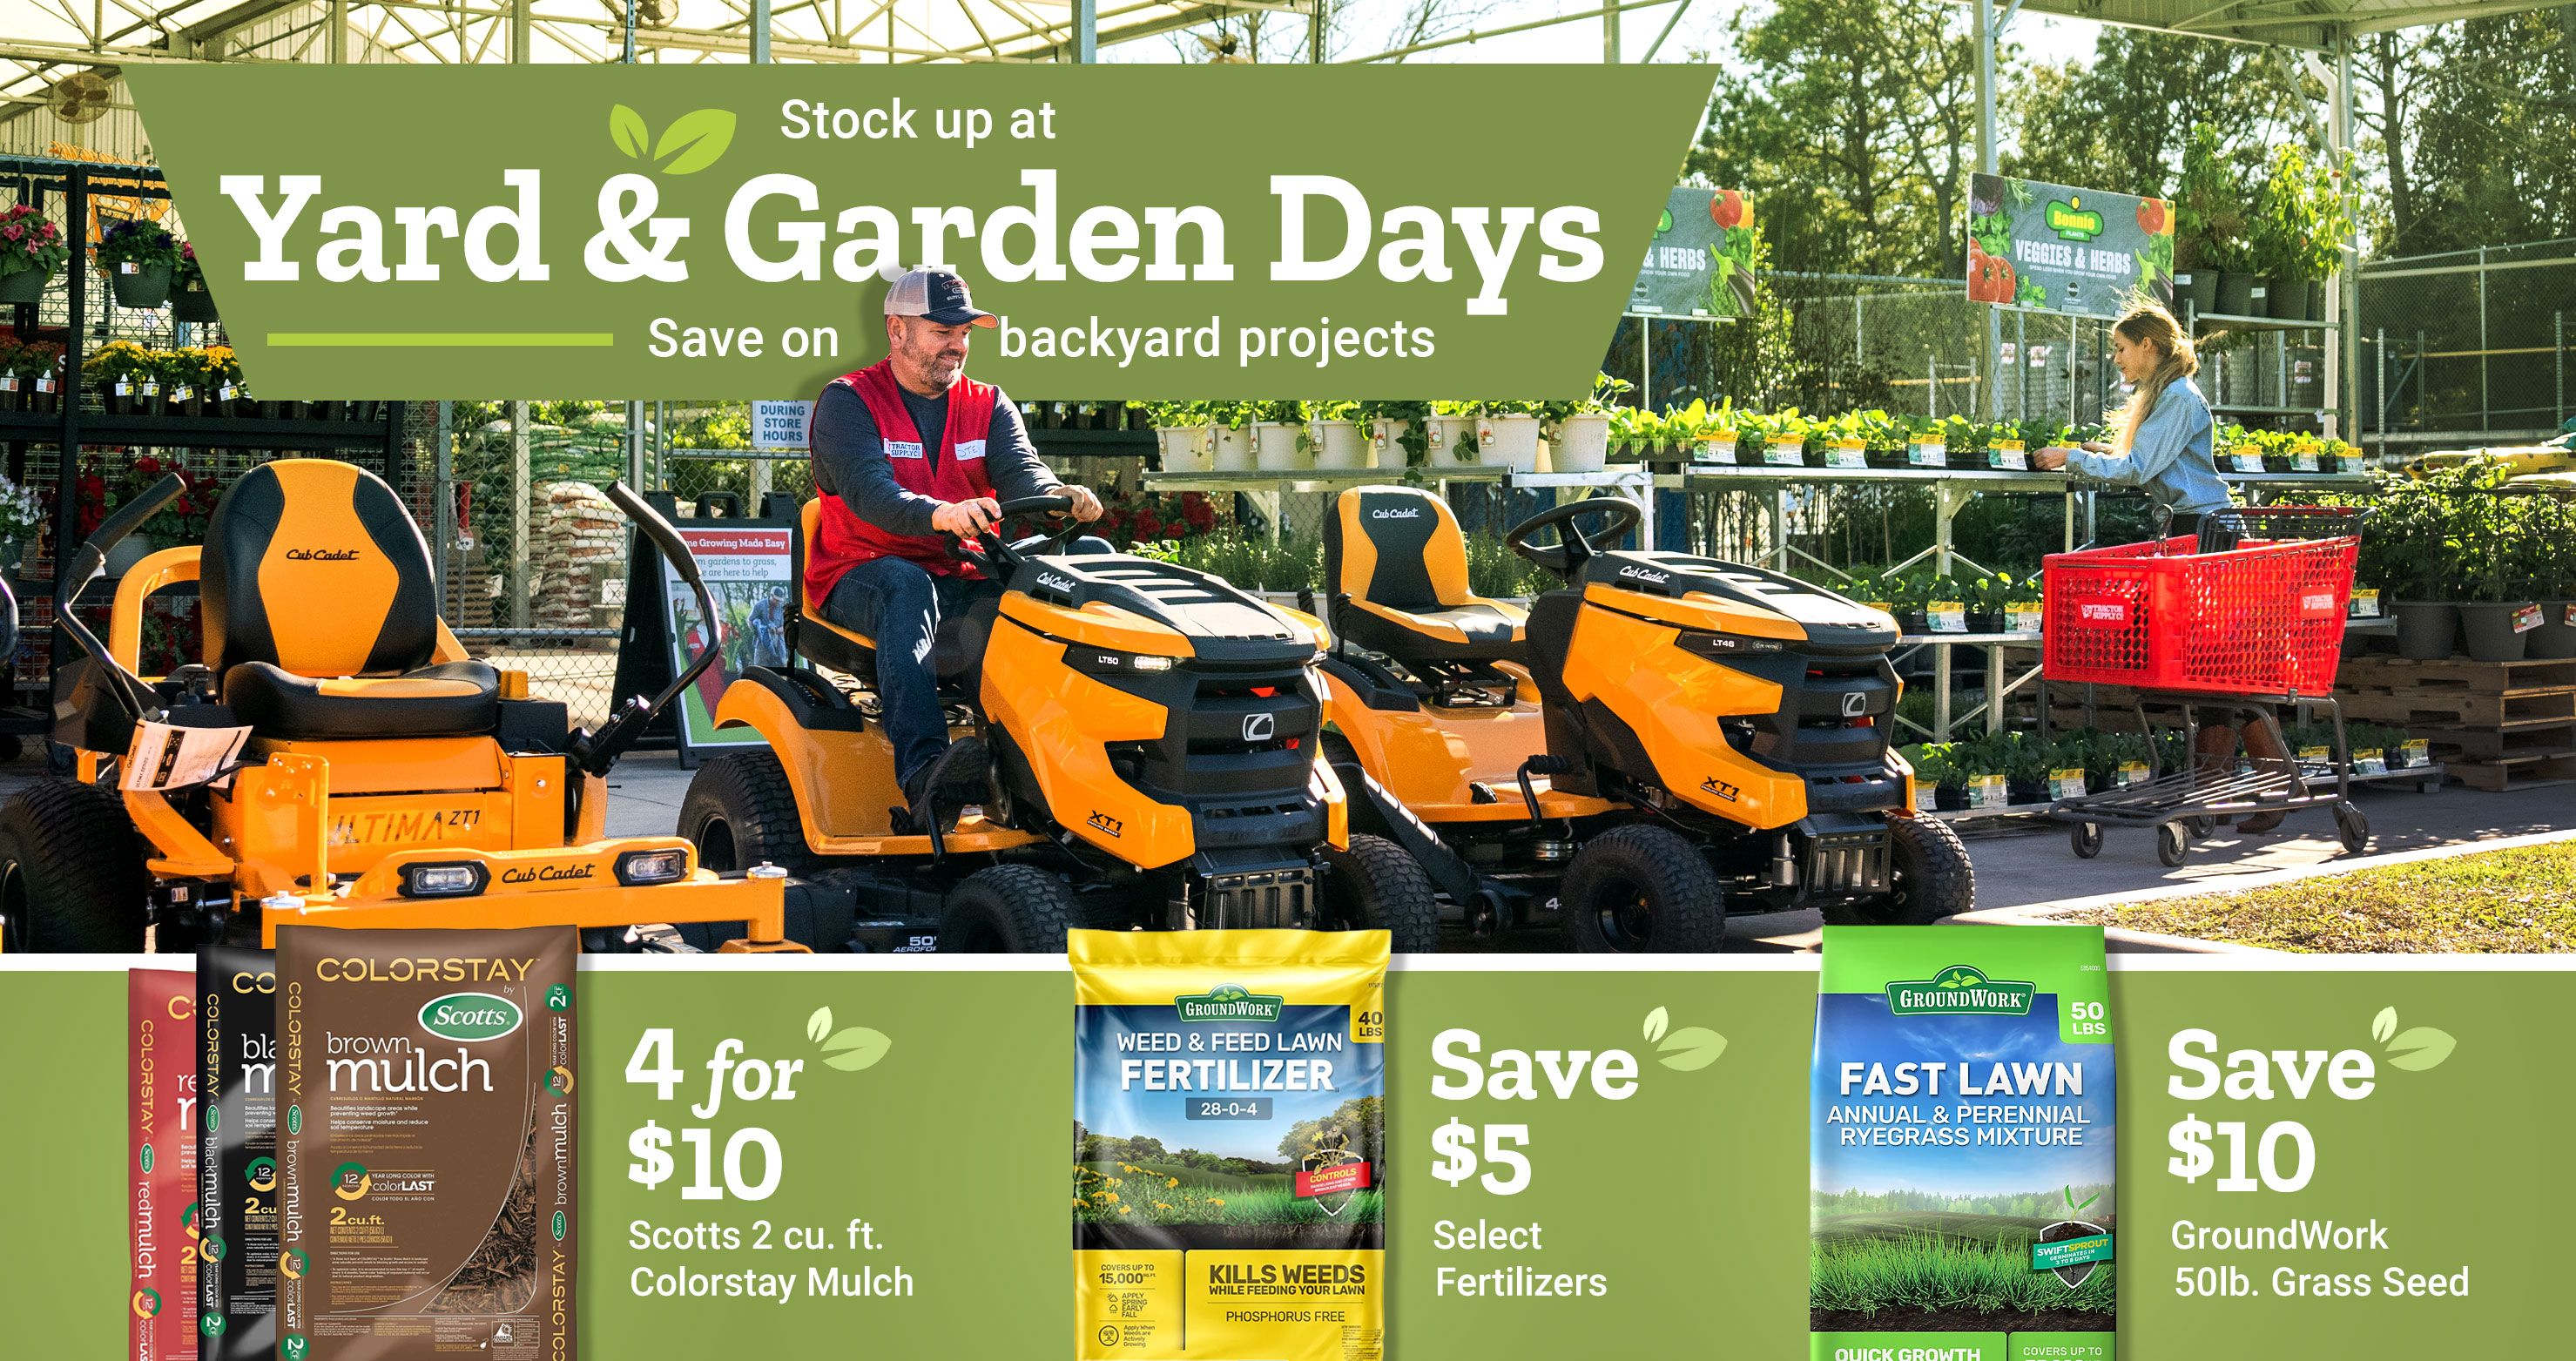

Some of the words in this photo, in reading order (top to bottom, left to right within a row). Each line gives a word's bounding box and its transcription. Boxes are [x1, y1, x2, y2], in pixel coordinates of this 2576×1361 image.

[2053, 210, 2095, 230] Bonnie
[1660, 246, 1706, 271] HERBS
[2015, 239, 2072, 267] VEGGIES
[2074, 247, 2086, 269] &
[2090, 249, 2131, 274] HERBS
[760, 406, 805, 417] DURING
[764, 418, 801, 428] STORE
[763, 430, 803, 441] HOURS
[891, 442, 921, 451] TRACTOR
[1372, 509, 1389, 519] Cub
[1390, 508, 1419, 519] Cadet
[699, 538, 738, 549] Growing
[739, 539, 763, 548] Made
[765, 539, 786, 549] Easy
[287, 549, 312, 561] Cub
[314, 549, 360, 561] Cadet
[708, 556, 740, 567] gardens
[753, 559, 777, 568] grass,
[724, 568, 740, 576] here
[753, 567, 769, 578] help
[1619, 565, 1638, 577] Cub
[1637, 569, 1670, 584] Cadet
[1036, 571, 1051, 585] Cub
[1049, 576, 1076, 593] Cadet
[1713, 639, 1735, 648] LT46
[1098, 656, 1119, 665] LT50
[1703, 776, 1739, 797] XT1
[448, 810, 481, 825] ZT1
[1089, 810, 1123, 832] XT1
[502, 868, 535, 884] Cub
[538, 863, 596, 881] Cadet
[316, 957, 535, 982] COLORSTAY
[503, 985, 516, 995] by
[550, 995, 566, 1007] 2
[433, 1005, 507, 1026] Scotts
[1358, 1011, 1383, 1025] 40
[2071, 1001, 2104, 1021] 50
[1359, 1027, 1382, 1036] LBS
[2073, 1022, 2106, 1035] LBS
[206, 993, 219, 1097] COLORSTAY
[288, 981, 302, 1096] COLORSTAY
[327, 1031, 412, 1054] brown
[1117, 1033, 1181, 1052] WEED
[1189, 1033, 1205, 1052] &
[1211, 1033, 1271, 1052] FEED
[1278, 1033, 1342, 1052] LAWN
[141, 1020, 153, 1135] COLORSTAY
[327, 1047, 494, 1093] mulch
[1121, 1059, 1334, 1091] FERTILIZER
[1841, 1062, 1946, 1095] FAST
[1959, 1062, 2083, 1095] LAWN
[1201, 1102, 1258, 1116] 28-0-4
[1827, 1106, 1926, 1124] ANNUAL
[1932, 1106, 1950, 1124] &
[1958, 1106, 2091, 1124] PERENNIAL
[1841, 1128, 1970, 1146] RYEGRASS
[1977, 1128, 2083, 1146] MIXTURE
[551, 1103, 567, 1205] brownmulch
[258, 1167, 271, 1176] 12
[344, 1174, 359, 1184] 12
[1310, 1168, 1357, 1183] CONTROLS
[205, 1137, 221, 1230] blackmulch
[373, 1180, 435, 1192] colorLAST
[287, 1141, 303, 1243] brownmulch
[245, 1197, 260, 1214] 2
[330, 1206, 347, 1225] 2
[347, 1215, 385, 1225] cu.ft.
[138, 1181, 156, 1279] redmulch
[180, 1245, 196, 1264] 2
[2049, 1250, 2087, 1261] GERMINATES
[1099, 1272, 1143, 1285] 15,000
[1210, 1264, 1277, 1284] KILLS
[1282, 1264, 1366, 1284] WEEDS
[1209, 1285, 1244, 1296] WHILE
[1247, 1285, 1296, 1296] FEEDING
[1298, 1285, 1331, 1296] YOUR
[1333, 1285, 1366, 1296] LAWN
[552, 1250, 565, 1361] COLORSTAY
[206, 1316, 221, 1327] 2
[1226, 1310, 1312, 1322] PHOSPHORUS
[1315, 1310, 1345, 1322] FREE
[287, 1338, 304, 1350] 2
[2023, 1346, 2067, 1357] COVERS
[2070, 1346, 2086, 1357] UP
[2088, 1346, 2103, 1357] TO
[1835, 1348, 1893, 1361] QUICK
[1898, 1348, 1980, 1361] GROWTH
